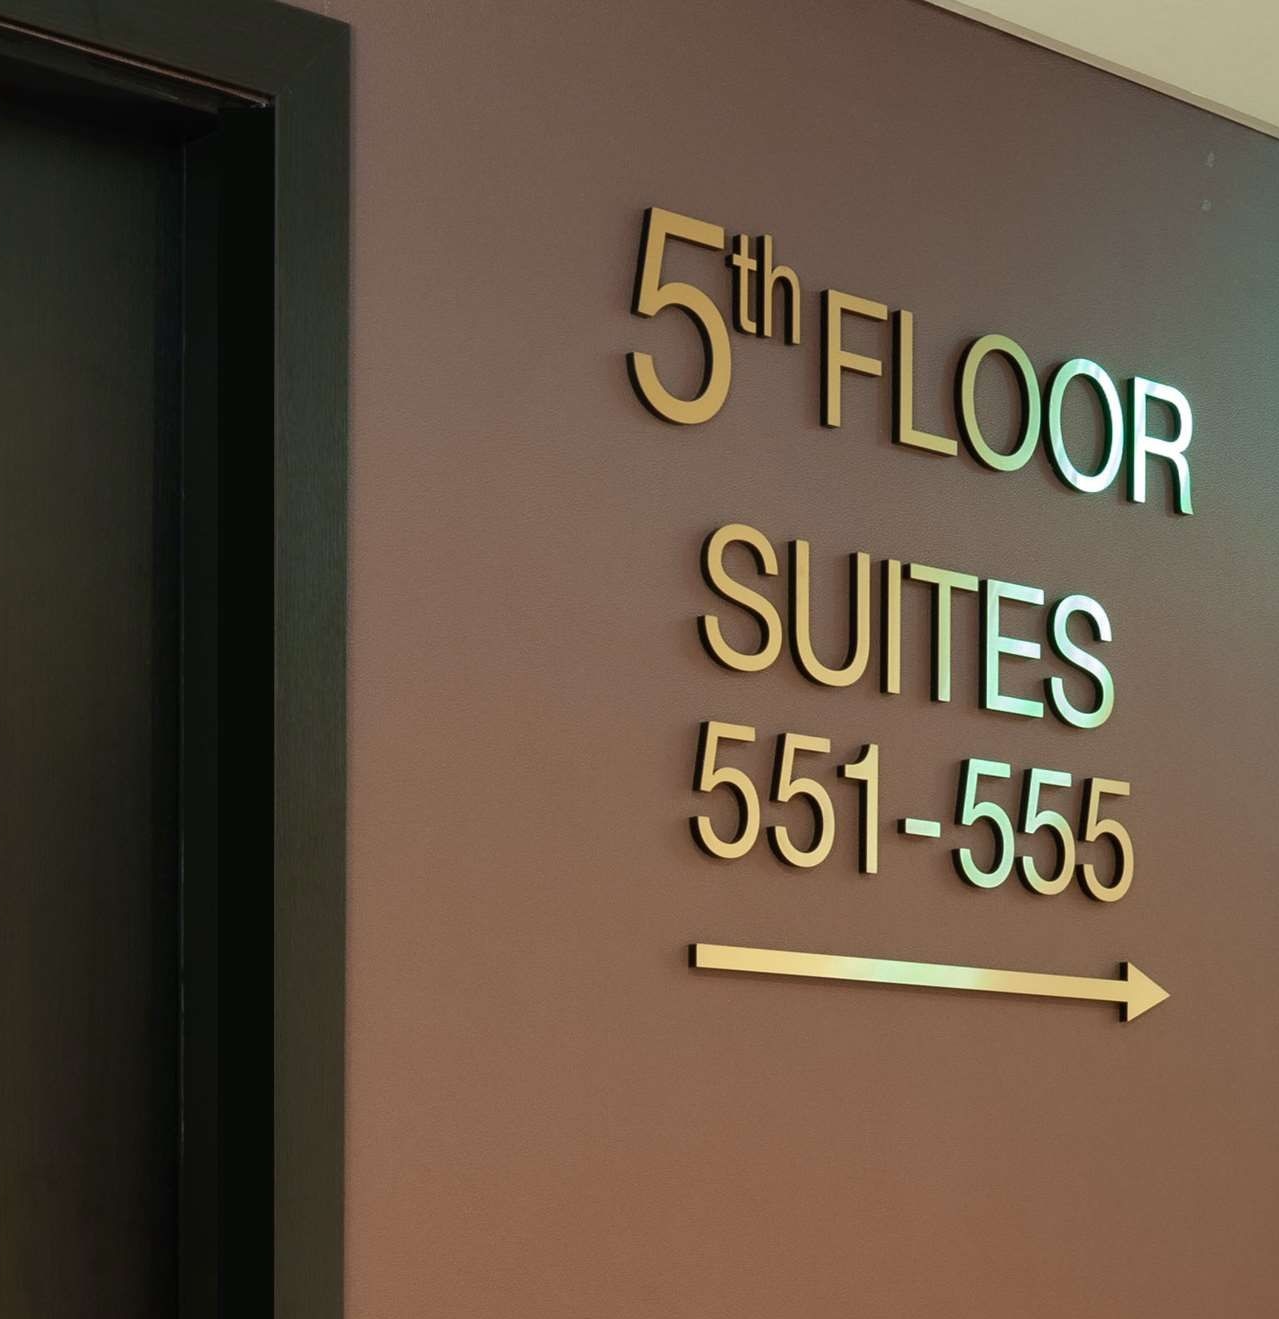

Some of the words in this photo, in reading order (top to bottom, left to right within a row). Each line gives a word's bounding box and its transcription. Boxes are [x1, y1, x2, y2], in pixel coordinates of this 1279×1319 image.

[627, 206, 800, 425] 5th
[822, 288, 1193, 515] FLOOR
[699, 523, 1115, 729] SUITES
[691, 721, 1135, 902] 551-555
